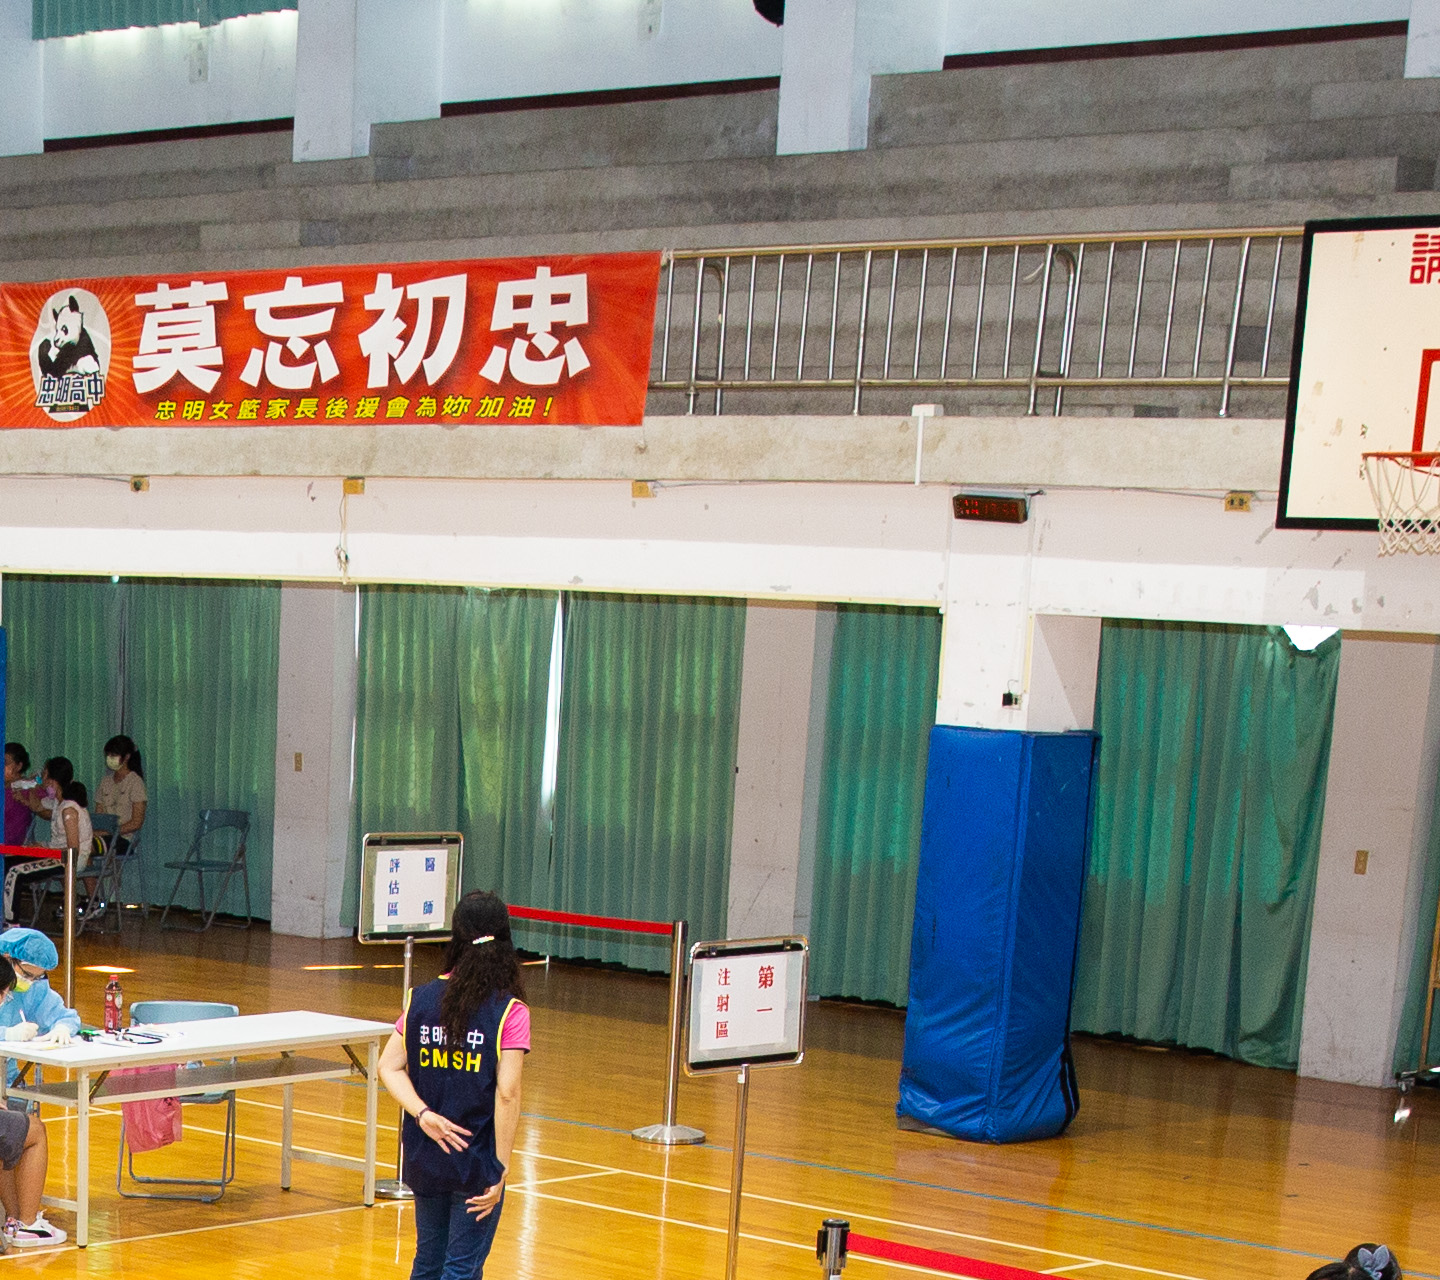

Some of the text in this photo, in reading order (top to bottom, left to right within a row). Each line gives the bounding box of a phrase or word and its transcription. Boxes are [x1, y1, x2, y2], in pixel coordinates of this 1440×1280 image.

[132, 266, 590, 395] 莫忘初忠
[39, 373, 105, 405] 忠明高中
[387, 857, 400, 917] 評估區
[422, 857, 435, 916] 醫師
[715, 967, 731, 1040] 注射區
[756, 964, 775, 1014] 第一
[420, 1025, 485, 1050] 忠明中
[420, 1046, 482, 1073] CMSH
